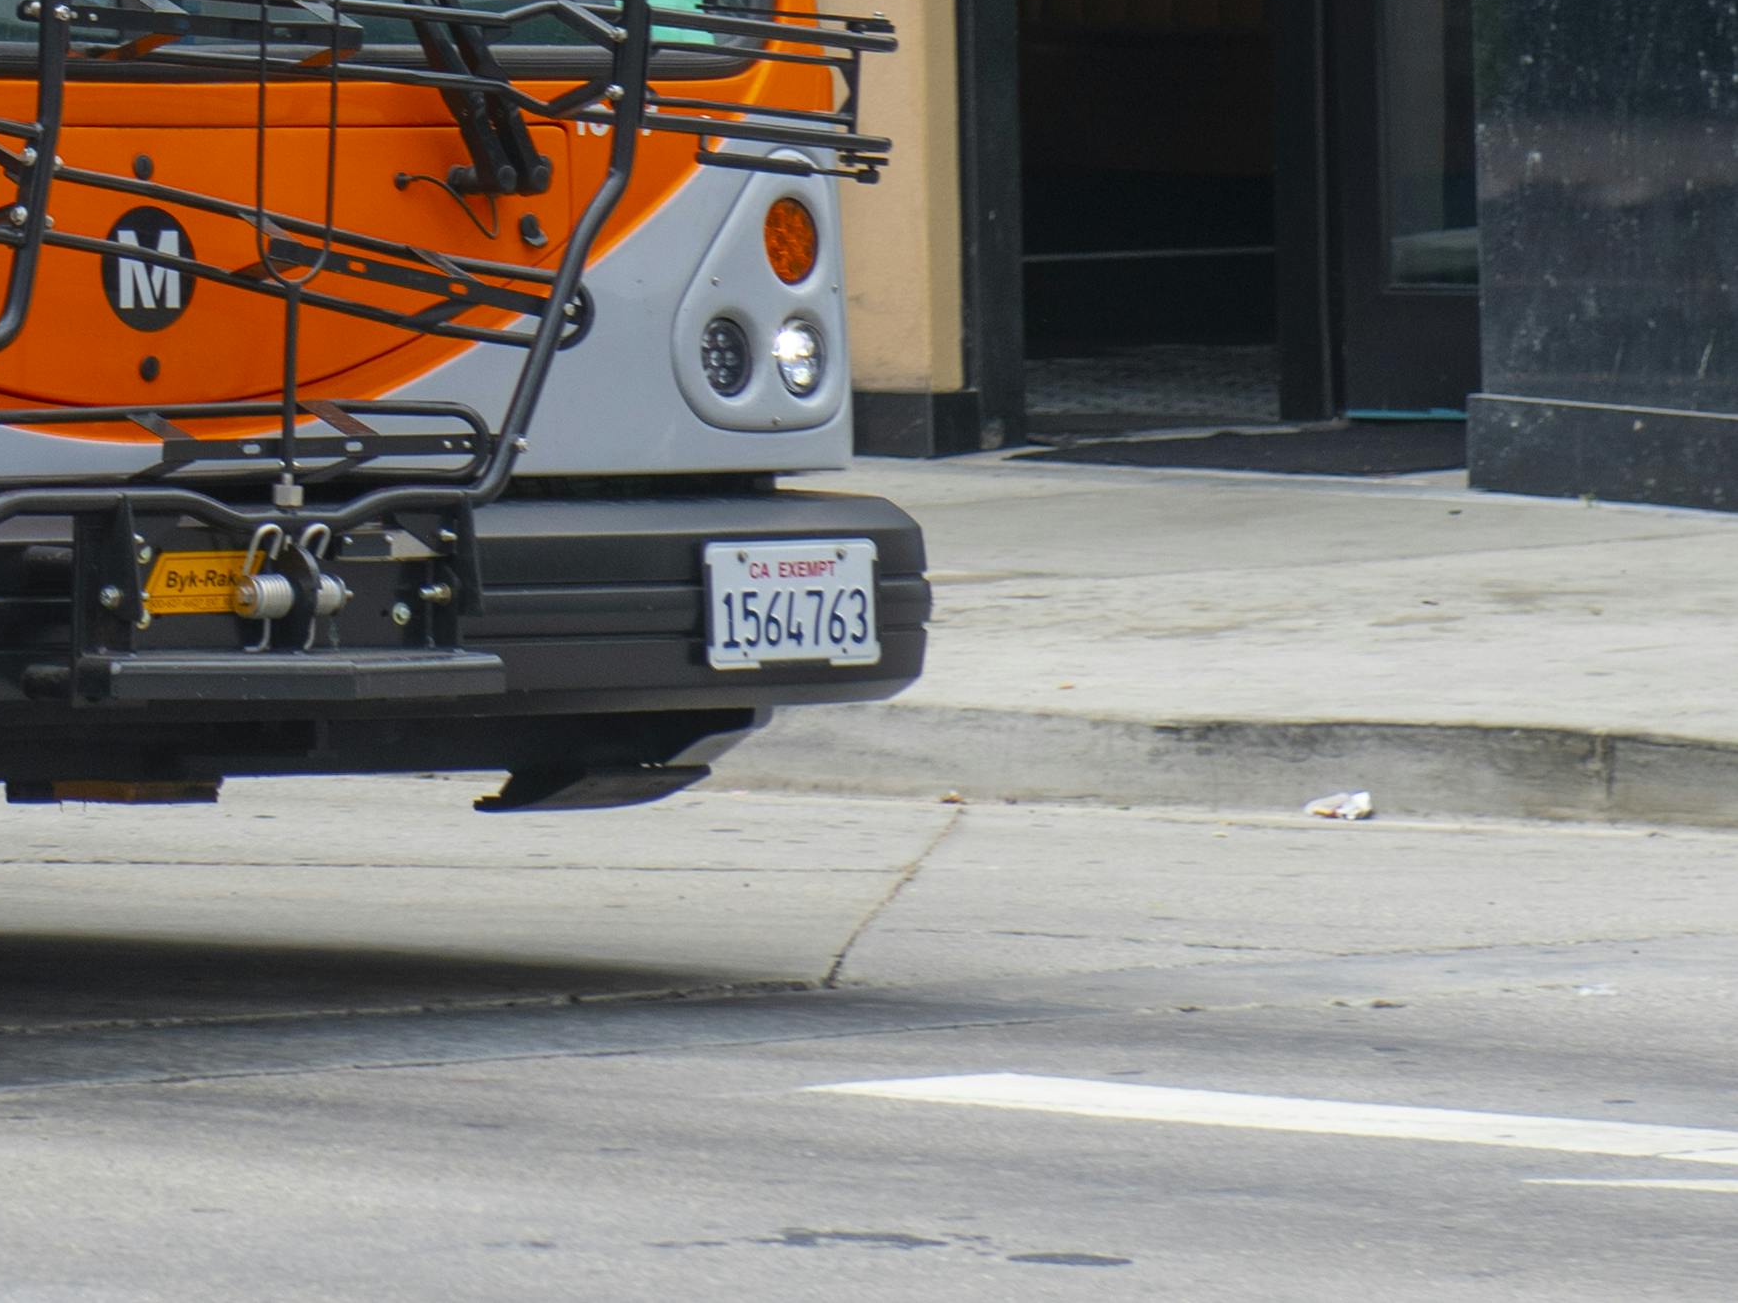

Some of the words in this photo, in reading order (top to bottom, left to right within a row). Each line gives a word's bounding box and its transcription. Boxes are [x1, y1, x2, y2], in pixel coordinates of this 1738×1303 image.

[749, 561, 770, 580] CA
[778, 560, 836, 579] EXEMPT
[723, 587, 868, 649] 1564763
